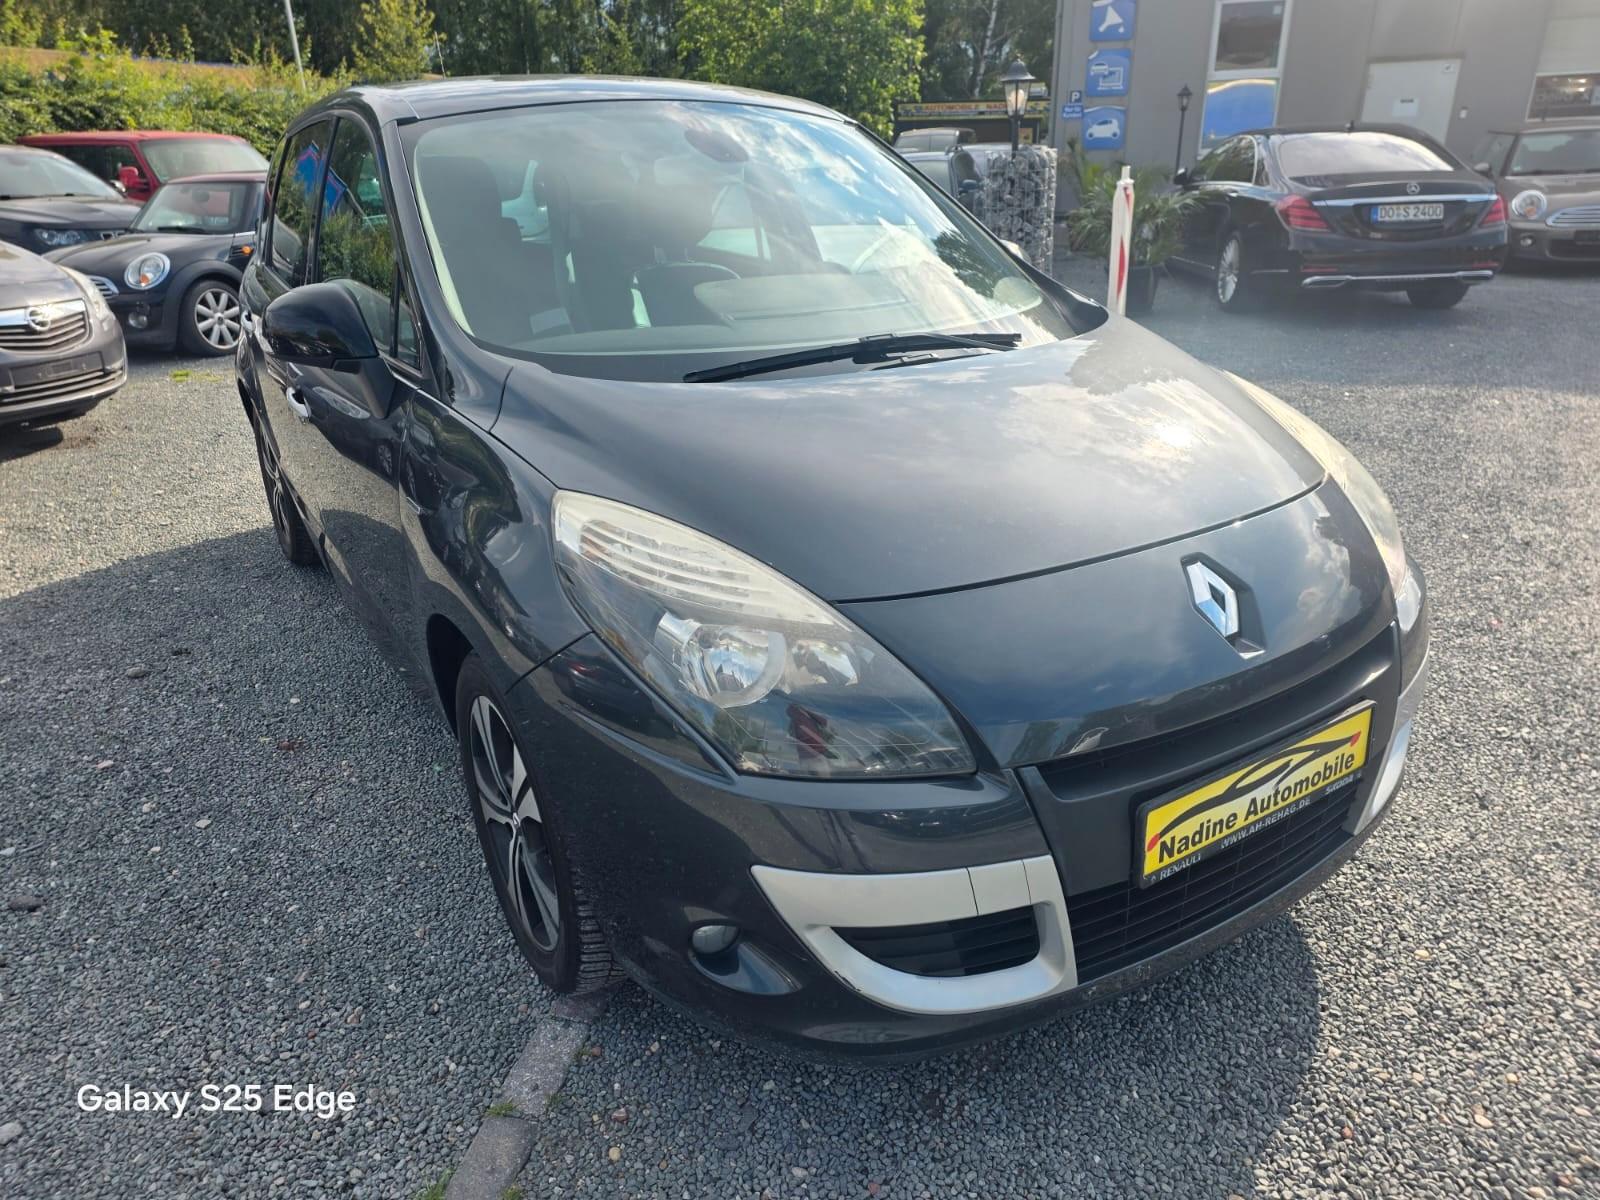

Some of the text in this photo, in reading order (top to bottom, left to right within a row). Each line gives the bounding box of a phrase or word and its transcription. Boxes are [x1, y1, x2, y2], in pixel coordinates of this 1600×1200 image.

[1071, 91, 1080, 102] P
[1158, 752, 1355, 864] Nadine Automobile
